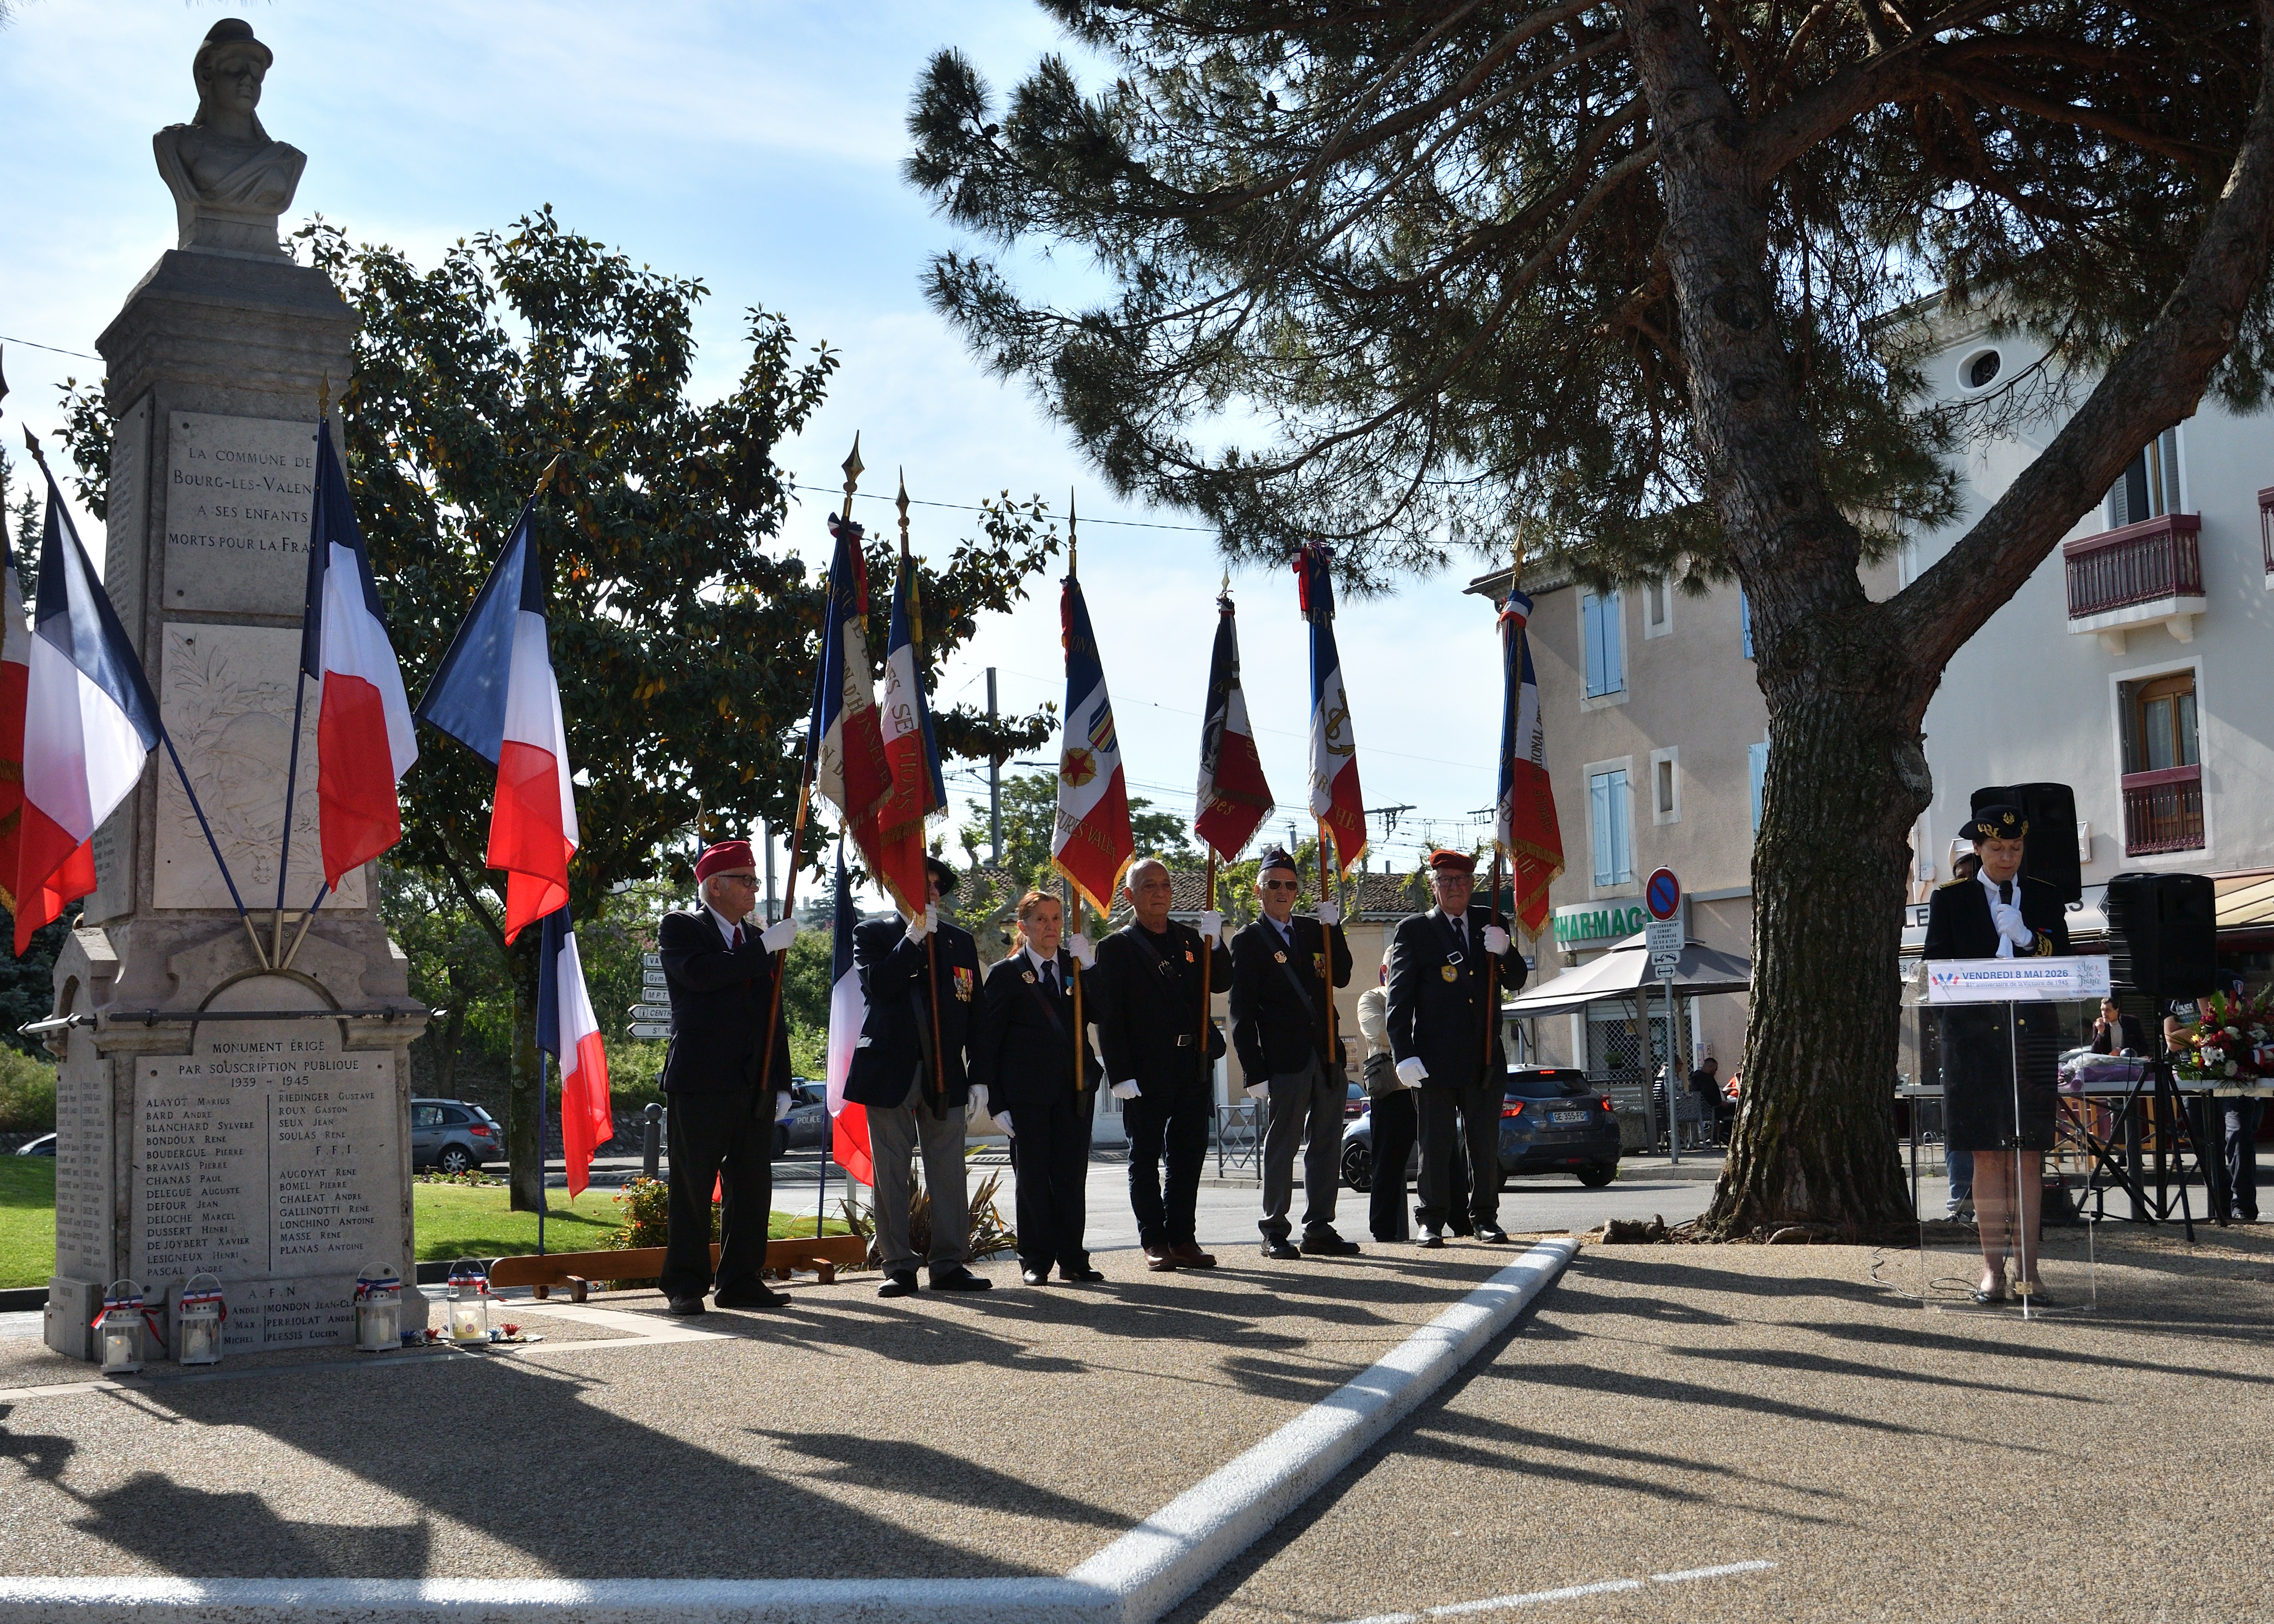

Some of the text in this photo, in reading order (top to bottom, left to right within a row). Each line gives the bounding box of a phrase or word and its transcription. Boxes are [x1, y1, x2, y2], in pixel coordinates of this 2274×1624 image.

[189, 448, 312, 468] LA COMMUNE DE
[174, 470, 315, 494] BOURG-LES-VALEN
[215, 506, 237, 517] SES
[246, 509, 307, 523] ENFANTS
[169, 533, 215, 547] MORTS
[220, 537, 254, 549] POUR
[260, 539, 276, 551] LA
[891, 703, 918, 812] SECTIONS
[1531, 728, 1544, 782] NATIONAL
[1534, 790, 1554, 834] CERCLE
[2081, 961, 2094, 971] Vive
[1962, 971, 2013, 979] VENDREDI
[2077, 973, 2100, 987] France
[213, 1042, 283, 1053] MONUMENT
[179, 1065, 201, 1074] PAR
[210, 1062, 296, 1074] SOUSCRIPTION
[232, 1078, 255, 1087] 1939
[283, 1076, 308, 1086] 1945
[146, 1098, 187, 1107] ALAYOT
[279, 1093, 329, 1102] RIEDINGER
[147, 1111, 173, 1120] BARD
[279, 1107, 306, 1115] ROUX
[1554, 1112, 1584, 1120] GE-355-FG
[797, 1115, 821, 1124] POLICE
[147, 1122, 209, 1132] BLANCHARD
[147, 1136, 194, 1145] BONDOUX
[279, 1132, 316, 1141] SOULAS
[147, 1161, 227, 1172] BRAVAIS PIERRE
[147, 1176, 191, 1185] CHANAS
[202, 1187, 240, 1195] AUGUSTE
[280, 1182, 310, 1191] BOMEL
[280, 1194, 325, 1204] CHALEAT
[147, 1200, 219, 1211] DEFOUR JEAN
[280, 1206, 340, 1217] GALLINOTTI
[147, 1213, 236, 1224] DELOCHE MARCEL
[280, 1218, 329, 1229] LONCHINO
[147, 1226, 227, 1237] DUSSERT HENRI
[280, 1232, 312, 1242] MASSE
[147, 1242, 160, 1250] DE
[164, 1239, 208, 1249] JOYBERT
[280, 1243, 363, 1255] PLANAS ANTOINE
[147, 1253, 203, 1264] LESIGNEUX
[147, 1267, 184, 1276] PASCAL
[267, 1302, 310, 1312] MONDON
[235, 1321, 255, 1330] MAX
[267, 1316, 321, 1327] PERRIOLAT
[223, 1336, 254, 1344] MICHEL
[267, 1330, 338, 1342] PLESSIS LUCIEN
